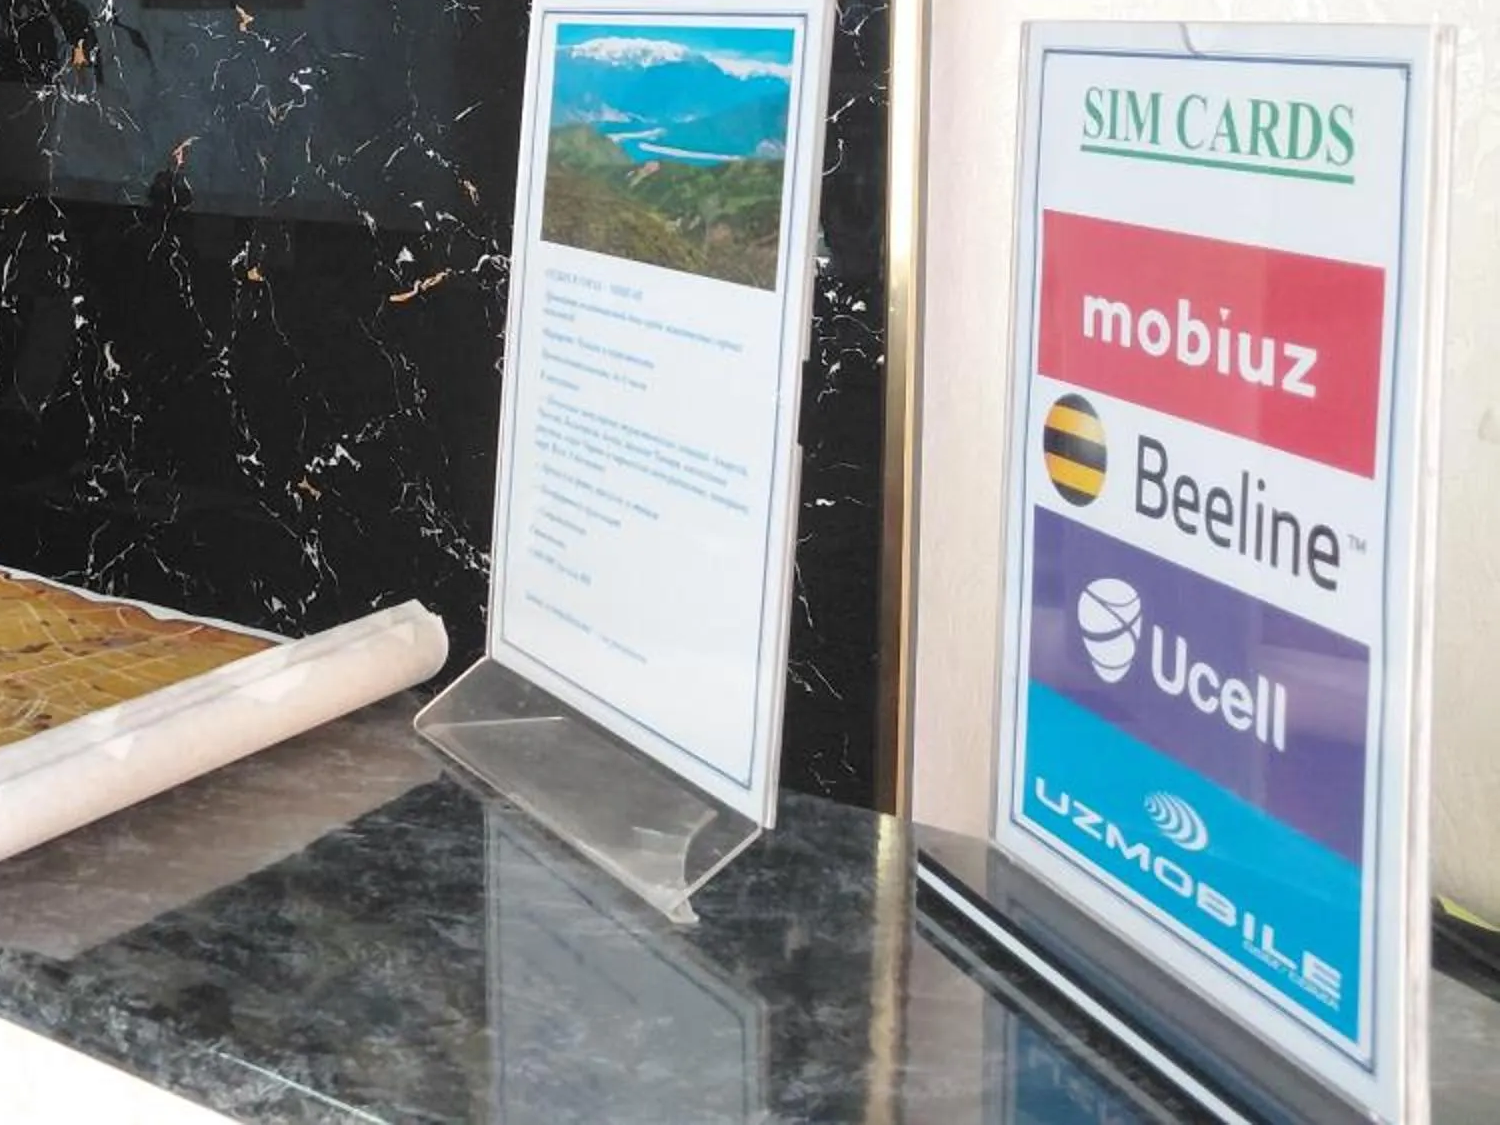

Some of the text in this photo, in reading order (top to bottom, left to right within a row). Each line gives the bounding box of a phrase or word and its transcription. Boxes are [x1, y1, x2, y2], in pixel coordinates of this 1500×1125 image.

[1083, 86, 1355, 167] SIM CARDS
[1083, 295, 1317, 398] mobiuz
[1135, 434, 1341, 591] Beeline
[1152, 625, 1287, 752] Ucell
[1035, 777, 1342, 1001] UZMOBILE
